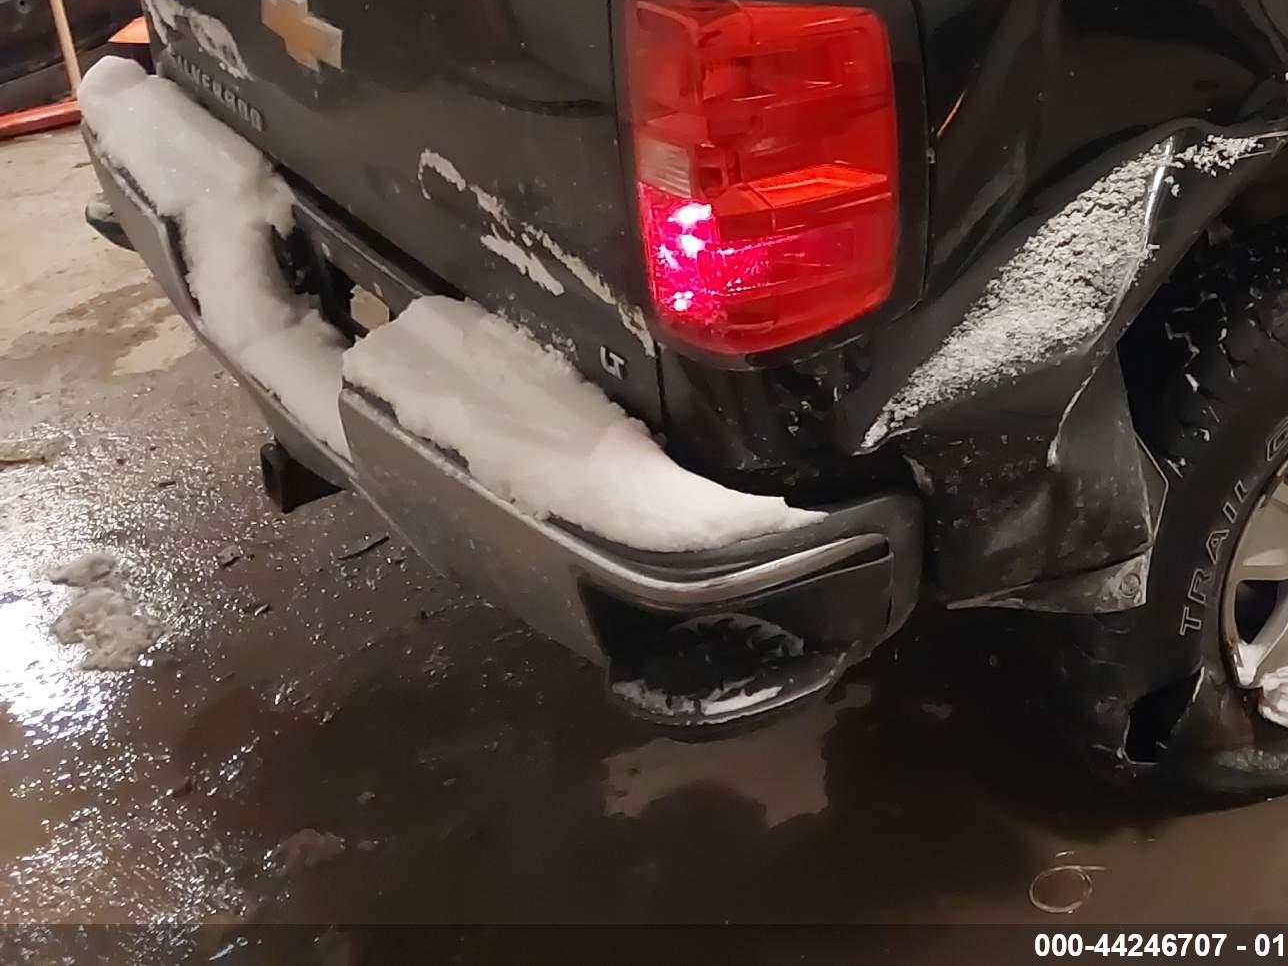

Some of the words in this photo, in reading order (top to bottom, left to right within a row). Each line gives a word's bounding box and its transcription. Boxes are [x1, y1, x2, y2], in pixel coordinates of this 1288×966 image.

[168, 46, 264, 131] ILVERADO
[600, 345, 625, 380] LT
[1180, 480, 1248, 636] TRAIL
